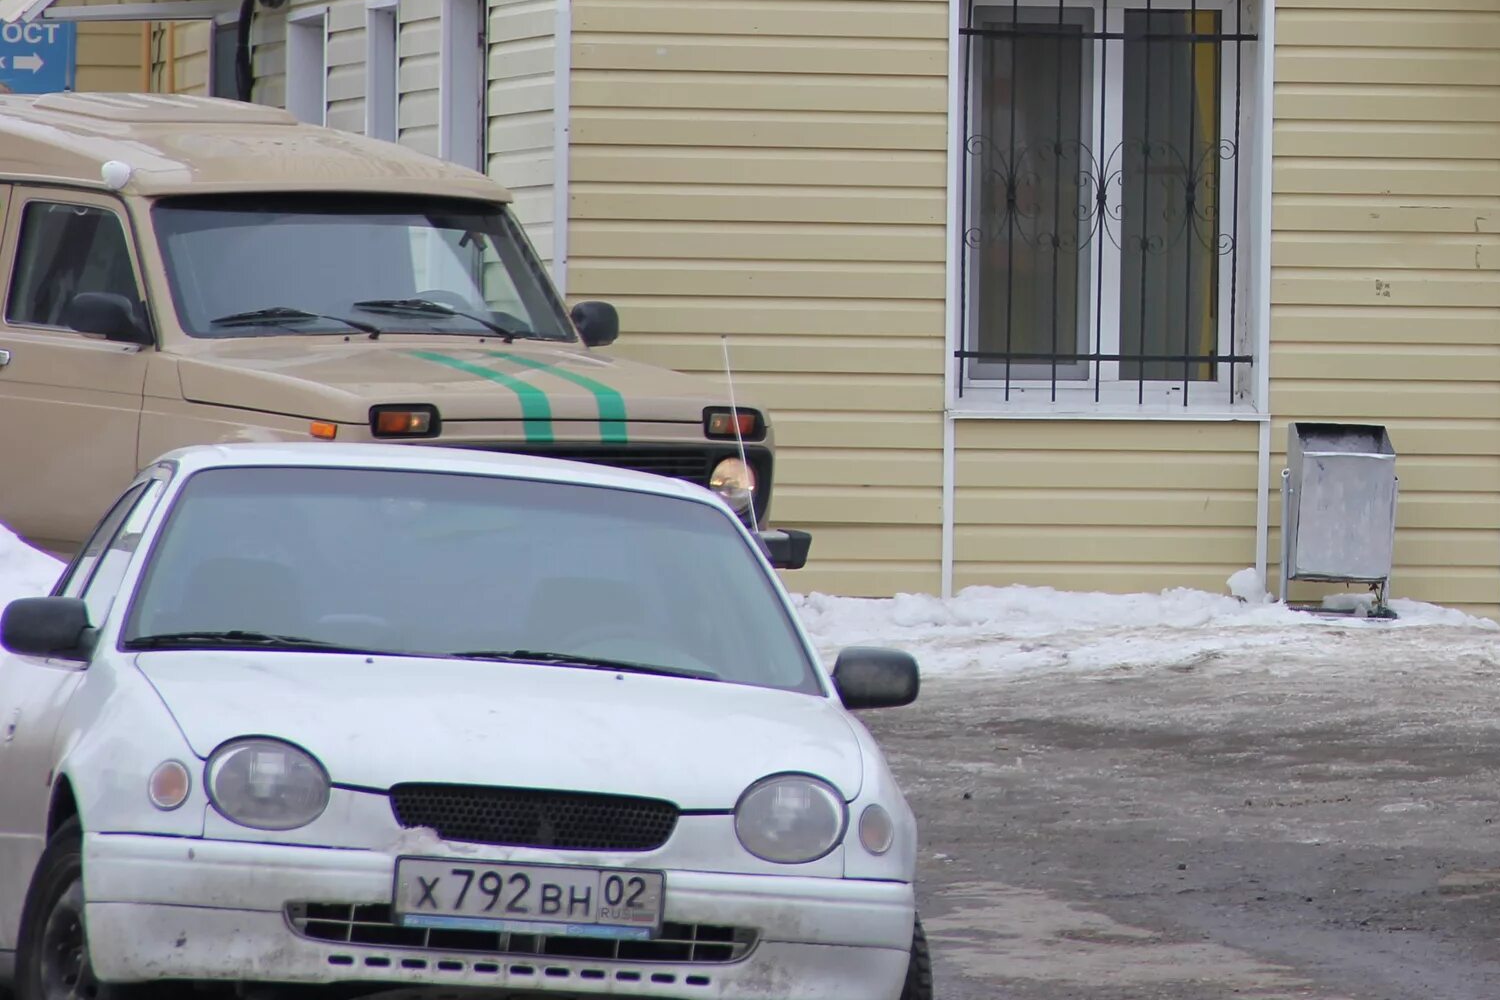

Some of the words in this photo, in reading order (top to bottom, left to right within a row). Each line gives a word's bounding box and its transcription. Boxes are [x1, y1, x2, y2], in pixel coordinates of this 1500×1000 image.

[416, 868, 592, 917] Х792ВН
[603, 874, 648, 908] 02
[600, 907, 632, 920] RUS
